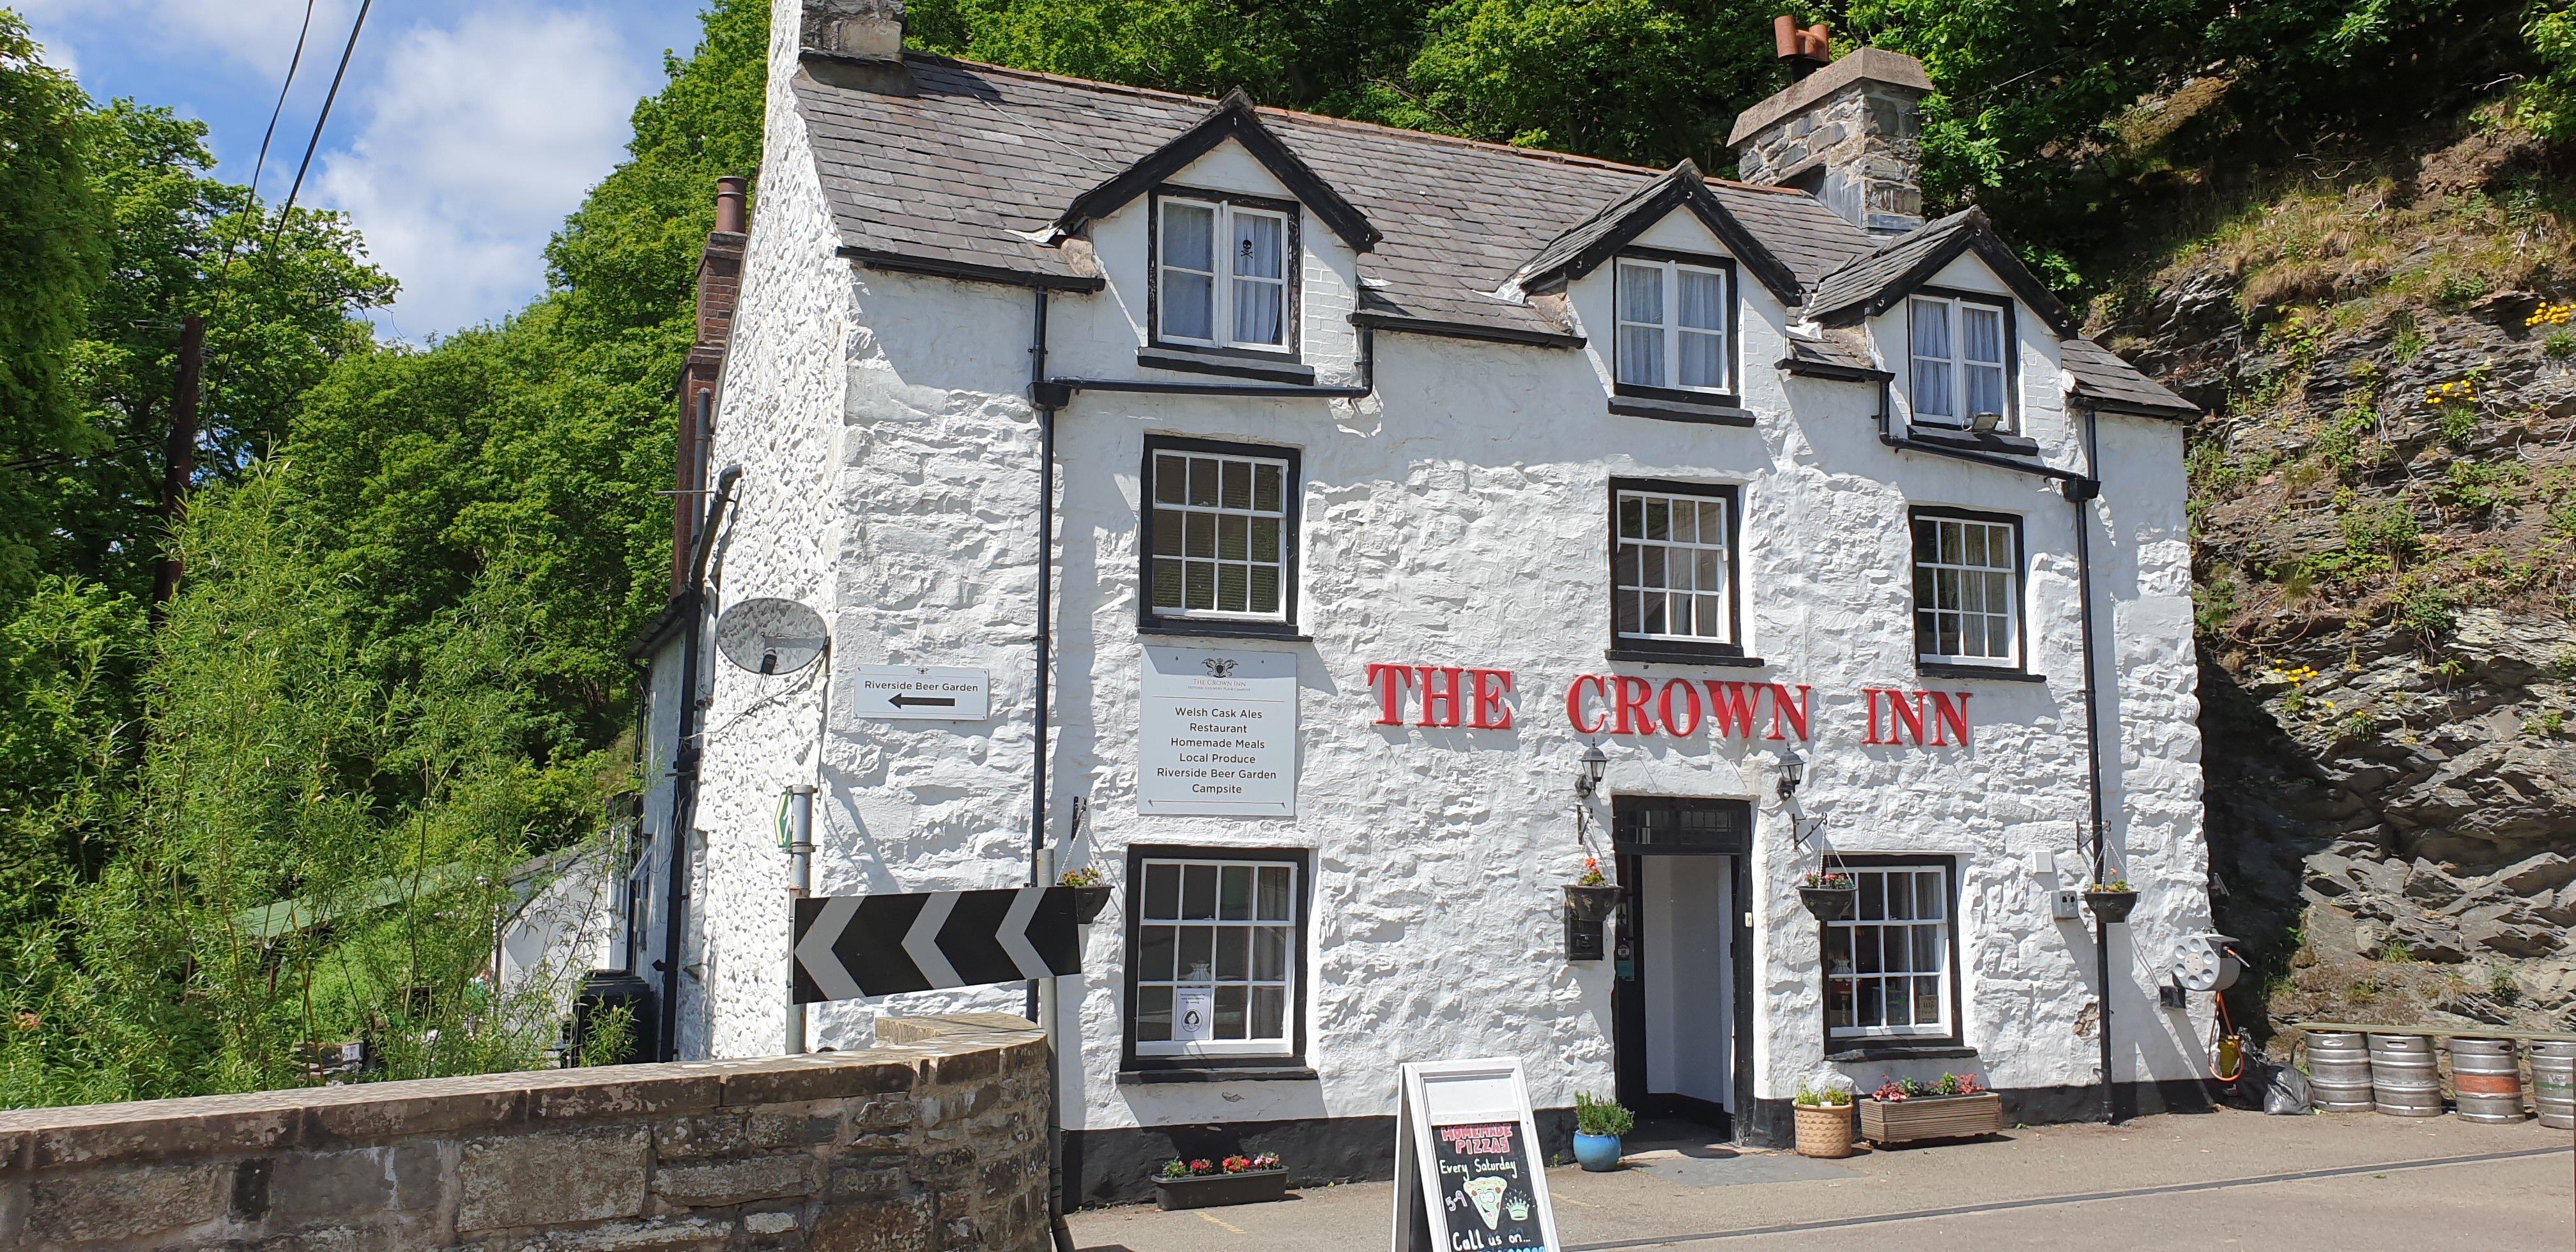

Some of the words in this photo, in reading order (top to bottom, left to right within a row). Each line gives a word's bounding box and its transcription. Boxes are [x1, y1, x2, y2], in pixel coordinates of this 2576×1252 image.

[864, 680, 912, 690] Riverside
[916, 682, 939, 691] Beer
[942, 683, 978, 692] Garden
[1367, 664, 1512, 730] THE
[1566, 675, 1812, 741] CROWN
[1862, 688, 1974, 747] INN
[1175, 706, 1208, 717] Welsh
[1211, 708, 1236, 718] Cask
[1239, 709, 1262, 719] Ales
[1190, 722, 1247, 733] Restaurant
[1171, 737, 1232, 747] Homemade
[1236, 739, 1265, 749] Meals
[1179, 752, 1208, 763] Local
[1212, 754, 1255, 763] Produce
[1157, 767, 1208, 777] Riverside
[1211, 768, 1235, 778] Beer
[1238, 769, 1276, 779] Garden
[1192, 784, 1242, 795] Campsite
[1441, 1123, 1513, 1141] HOMEMADE
[1455, 1137, 1510, 1154] PIZZAS
[1439, 1159, 1470, 1182] Every
[1474, 1156, 1517, 1179] Saturday
[1445, 1190, 1468, 1212] 5-9
[1452, 1228, 1485, 1251] Call
[1488, 1235, 1502, 1246] us
